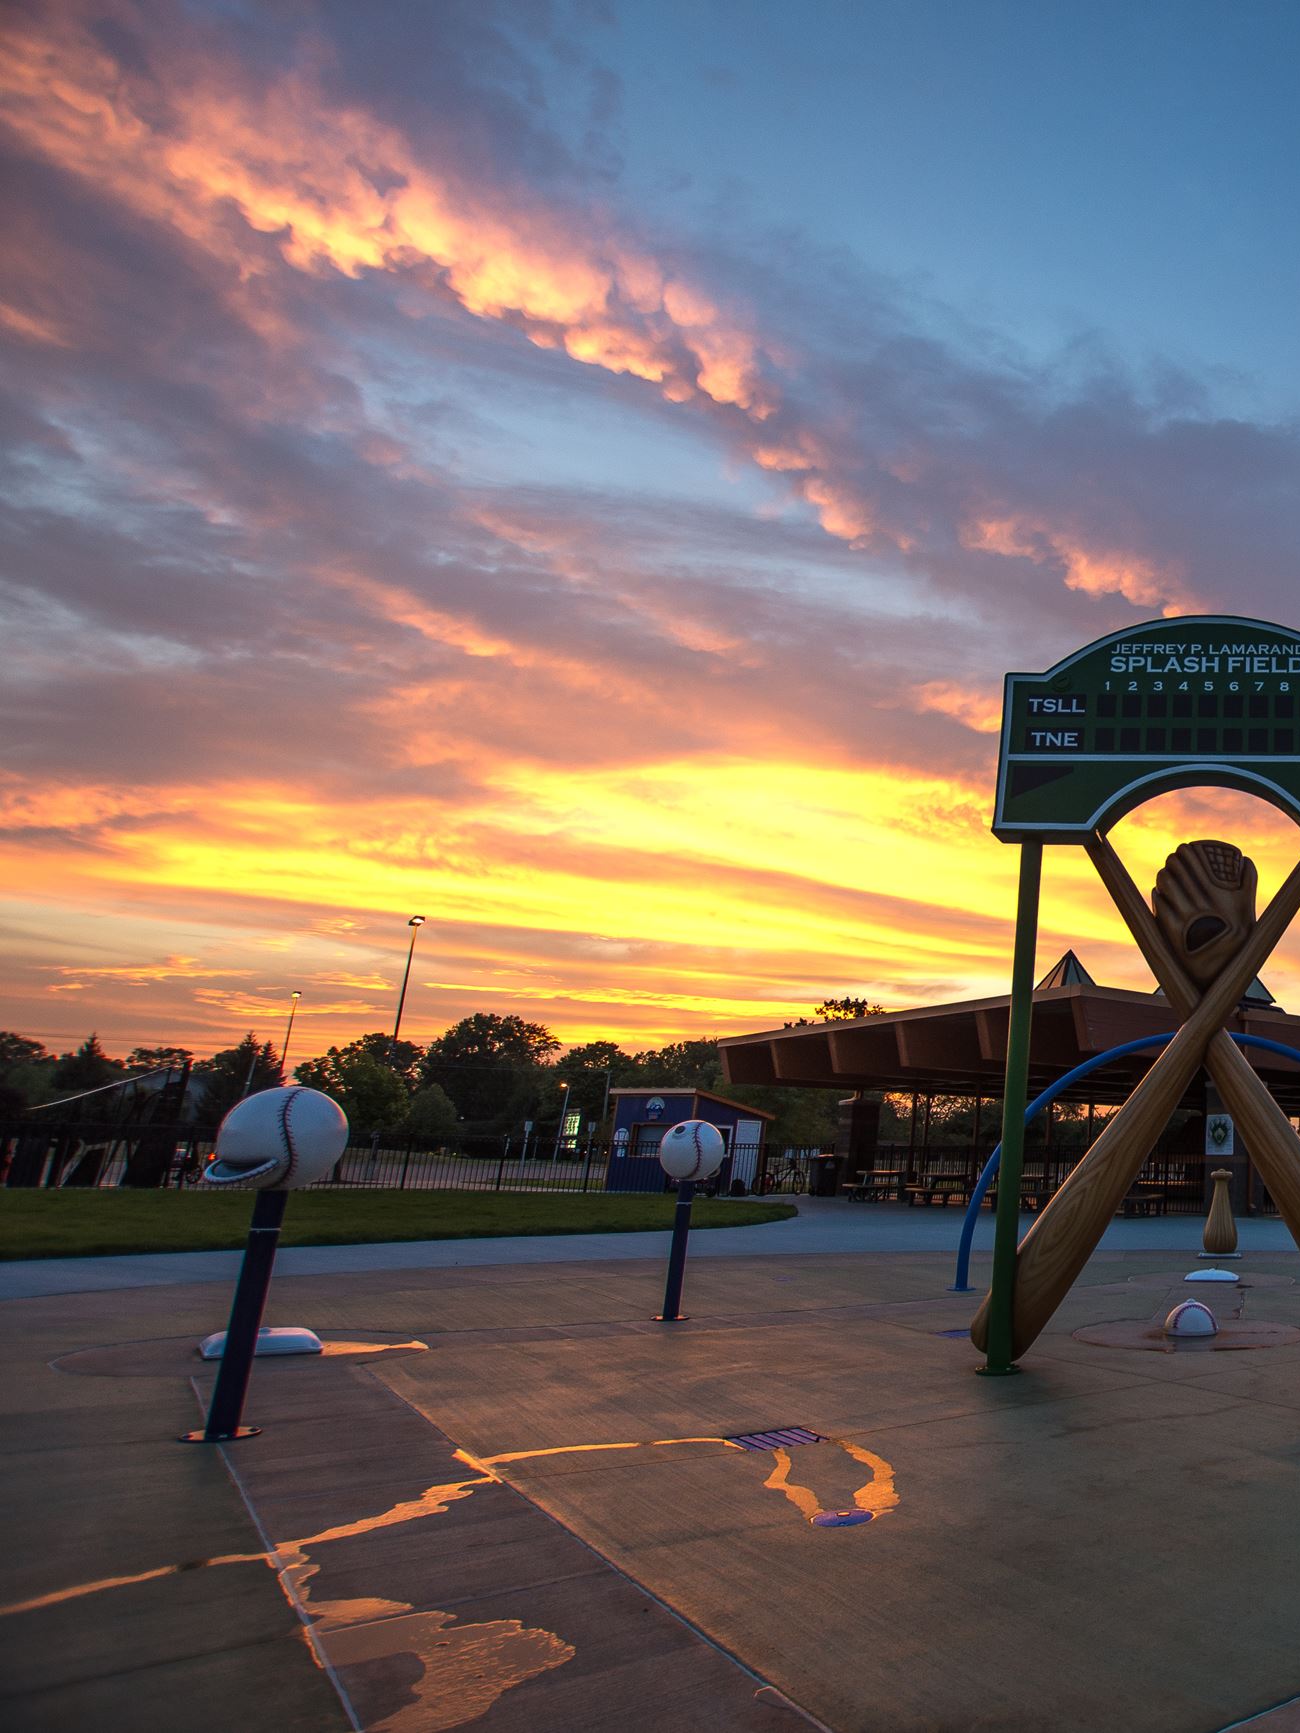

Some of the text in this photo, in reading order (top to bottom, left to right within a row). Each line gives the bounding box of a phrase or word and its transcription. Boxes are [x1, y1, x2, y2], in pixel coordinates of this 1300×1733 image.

[1111, 643, 1186, 655] JEFFREY
[1190, 644, 1204, 655] P.
[1110, 656, 1219, 673] SPLASH
[1104, 681, 1110, 690] 1
[1128, 681, 1138, 691] 2
[1153, 682, 1163, 691] 3
[1178, 682, 1188, 691] 4
[1204, 682, 1214, 691] 5
[1229, 682, 1239, 691] 6
[1254, 682, 1264, 691] 7
[1280, 682, 1290, 691] 8
[1029, 698, 1085, 713] TSLL
[1031, 732, 1078, 747] TNE
